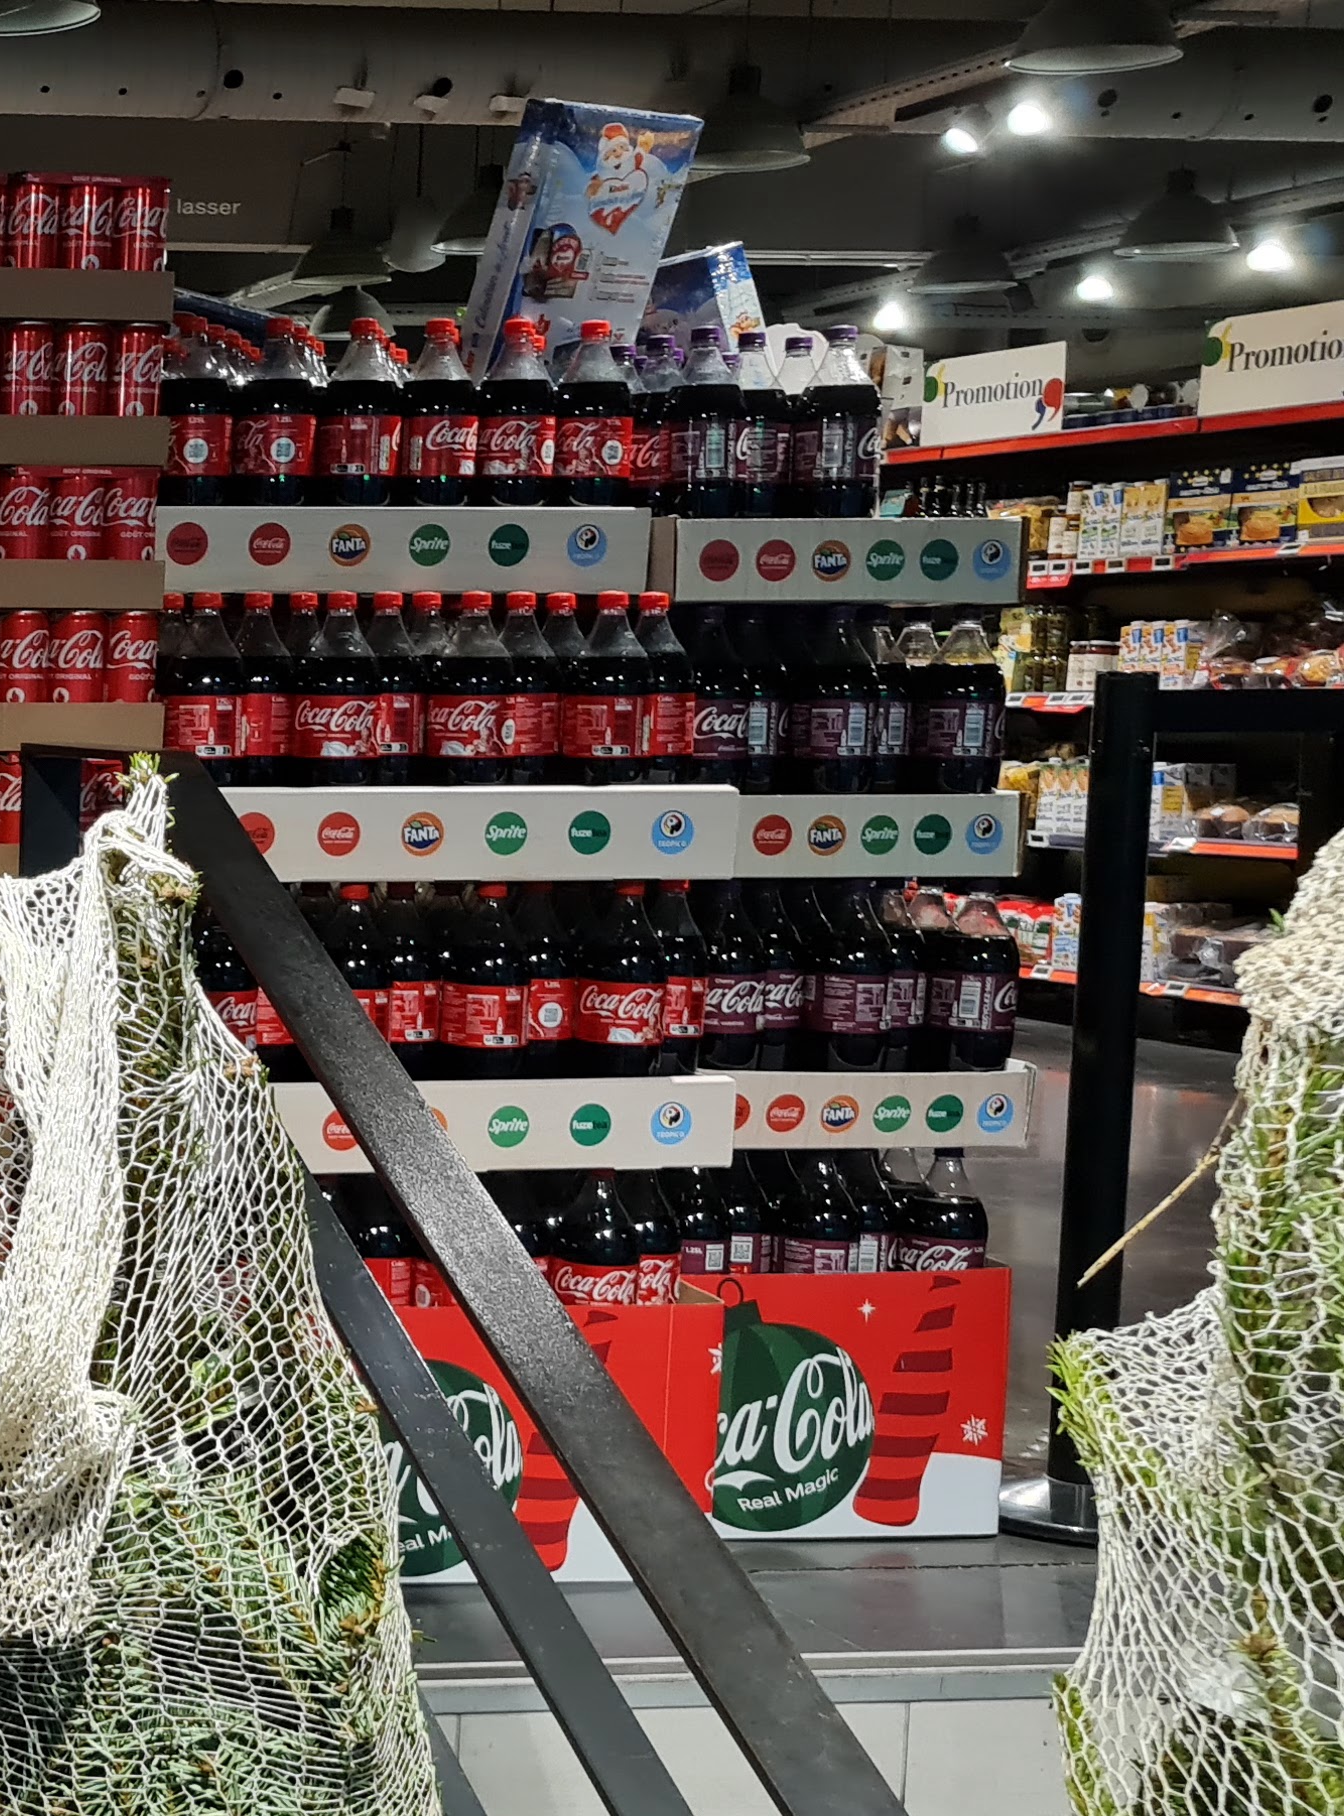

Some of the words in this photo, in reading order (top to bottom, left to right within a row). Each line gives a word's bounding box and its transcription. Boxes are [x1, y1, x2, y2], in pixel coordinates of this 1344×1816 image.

[941, 372, 1044, 408] Promotion
[331, 537, 367, 553] FANTA
[410, 537, 451, 553] Sprite
[814, 553, 848, 568] FANTA
[867, 552, 904, 567] Sprite
[295, 700, 377, 733] Coca-Cola
[403, 826, 441, 843] FANTA
[485, 825, 527, 840] Sprite
[809, 828, 844, 844] FANTA
[861, 827, 899, 841] Sprite
[580, 985, 664, 1020] Coca-Cola
[822, 1106, 856, 1122] FANTA
[874, 1105, 911, 1120] Sprite
[488, 1118, 529, 1134] Sprite
[737, 1492, 782, 1512] Real
[784, 1467, 839, 1503] Magic
